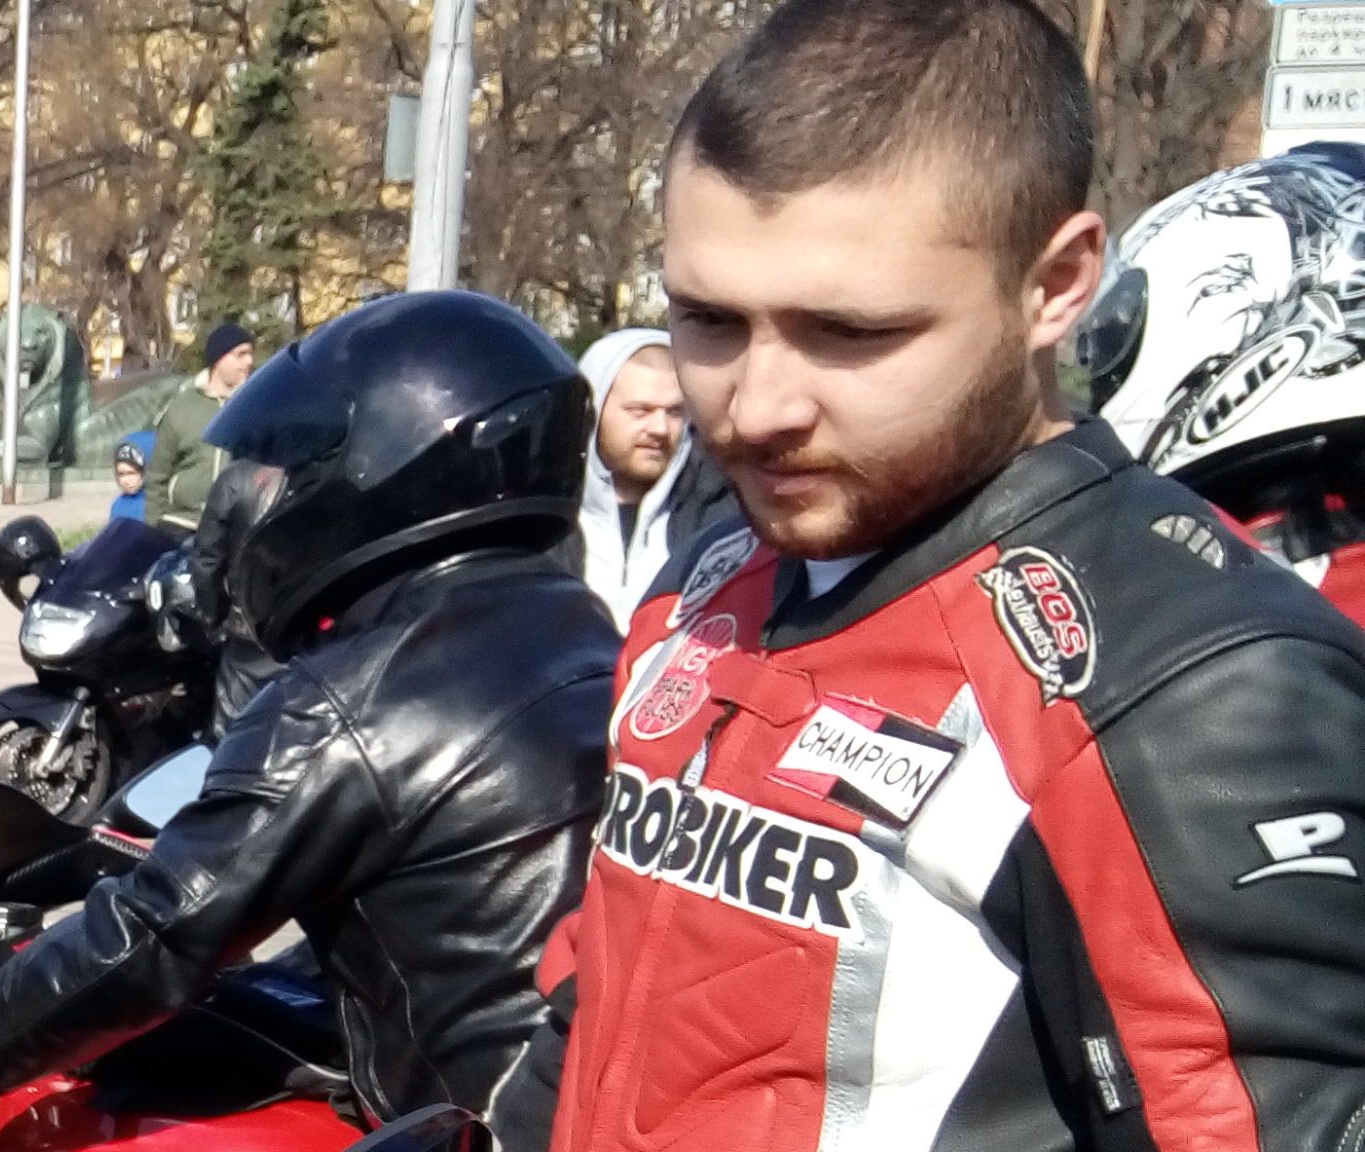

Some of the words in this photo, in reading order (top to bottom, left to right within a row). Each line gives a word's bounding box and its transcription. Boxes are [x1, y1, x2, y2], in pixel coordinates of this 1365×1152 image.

[1203, 343, 1290, 434] HJC
[1019, 561, 1089, 660] BOS
[797, 722, 933, 799] CHAMPION
[599, 765, 859, 933] ROBIKER
